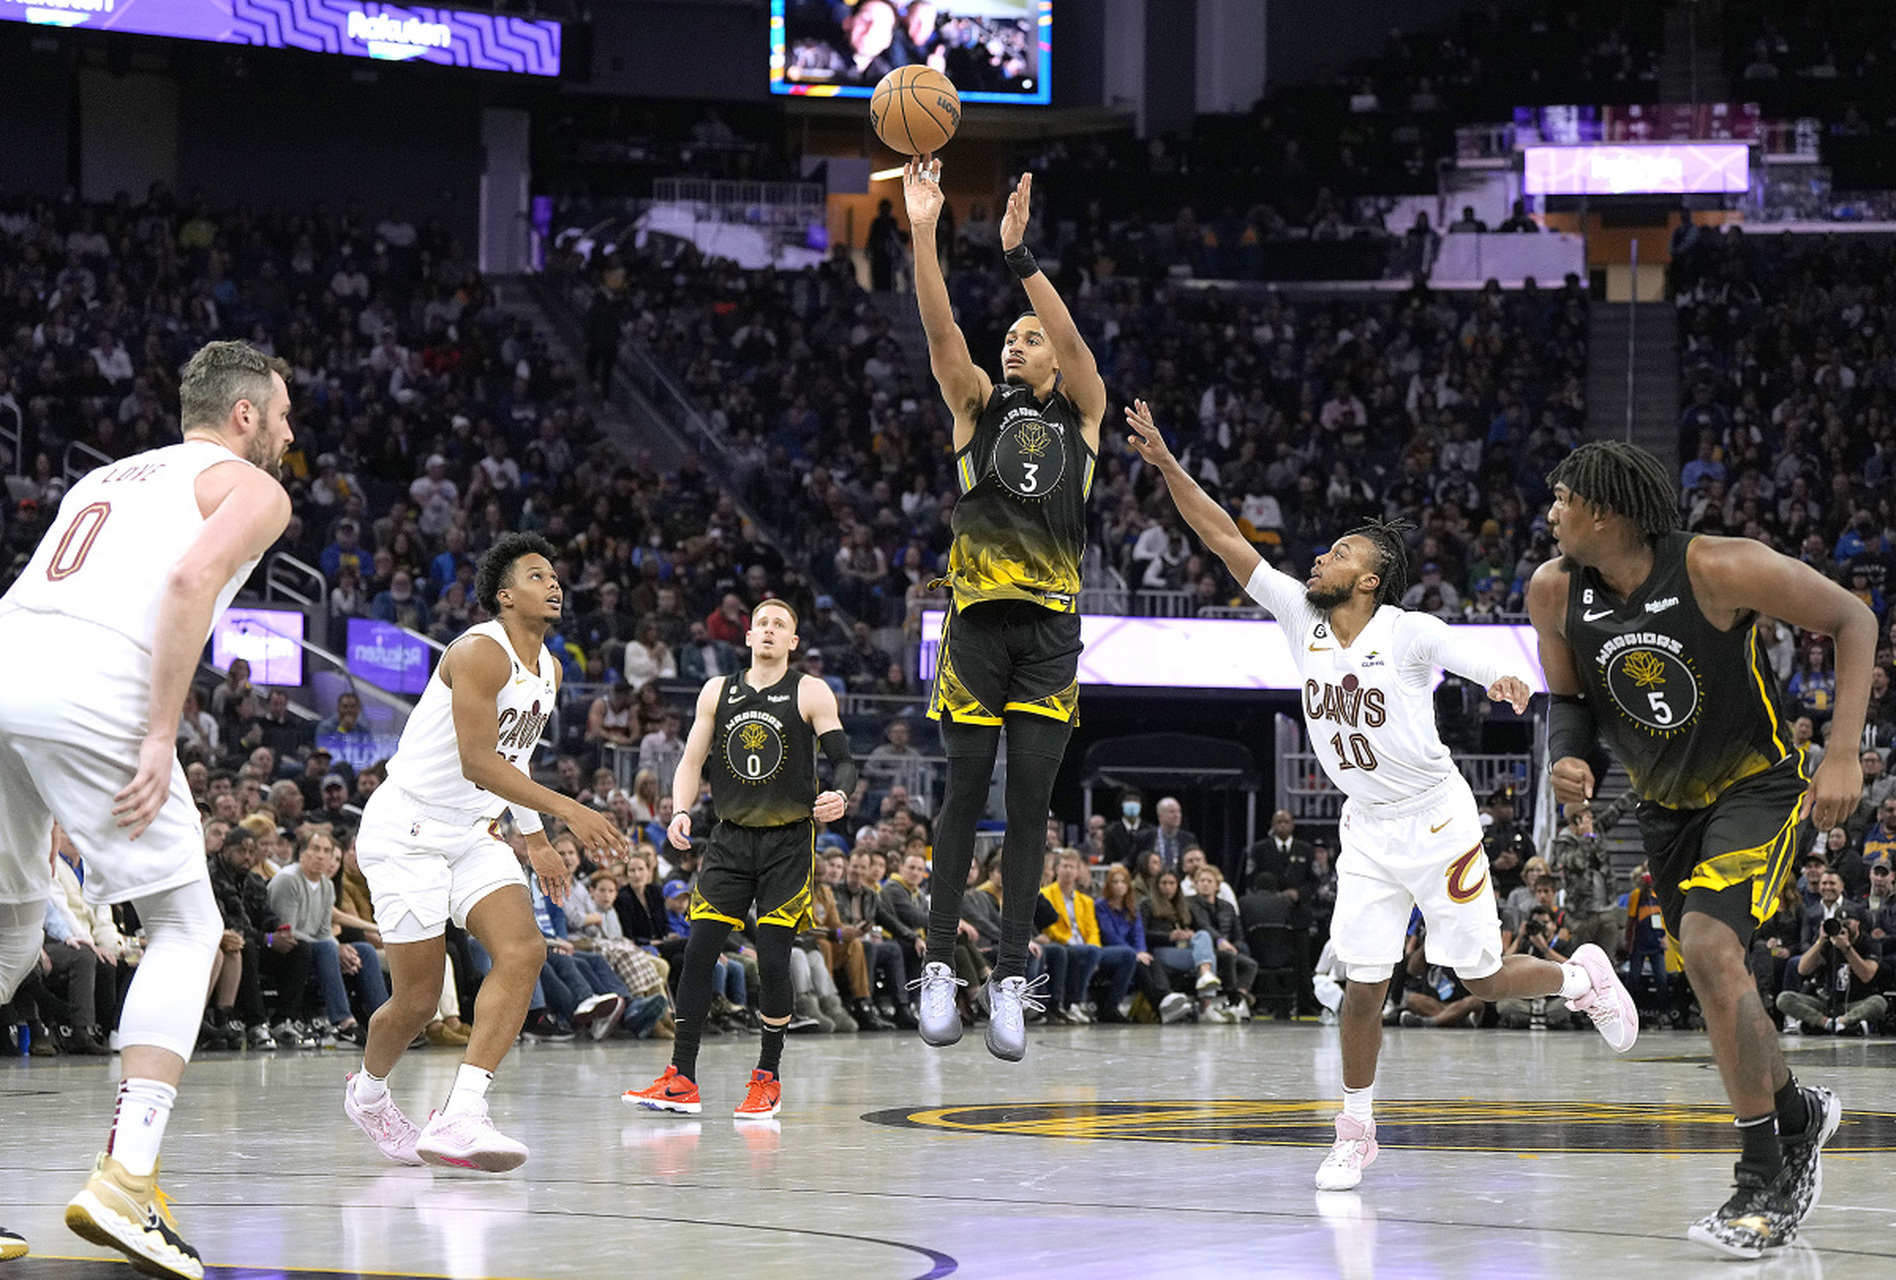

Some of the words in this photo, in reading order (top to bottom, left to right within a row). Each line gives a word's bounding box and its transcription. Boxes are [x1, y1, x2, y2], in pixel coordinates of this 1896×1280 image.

[348, 11, 451, 48] Rakuten
[101, 464, 166, 483] LOVE
[1019, 463, 1039, 492] 3
[46, 501, 112, 582] 0
[1583, 589, 1594, 604] 6
[1644, 597, 1679, 613] Rakuten
[1313, 624, 1327, 638] 6
[1595, 632, 1683, 665] WARRIORS
[729, 685, 738, 695] 6
[1305, 679, 1386, 728] CAVS
[1647, 691, 1673, 725] 5
[725, 710, 783, 731] WARRIORS
[1330, 732, 1378, 771] 10
[747, 754, 760, 777] 0
